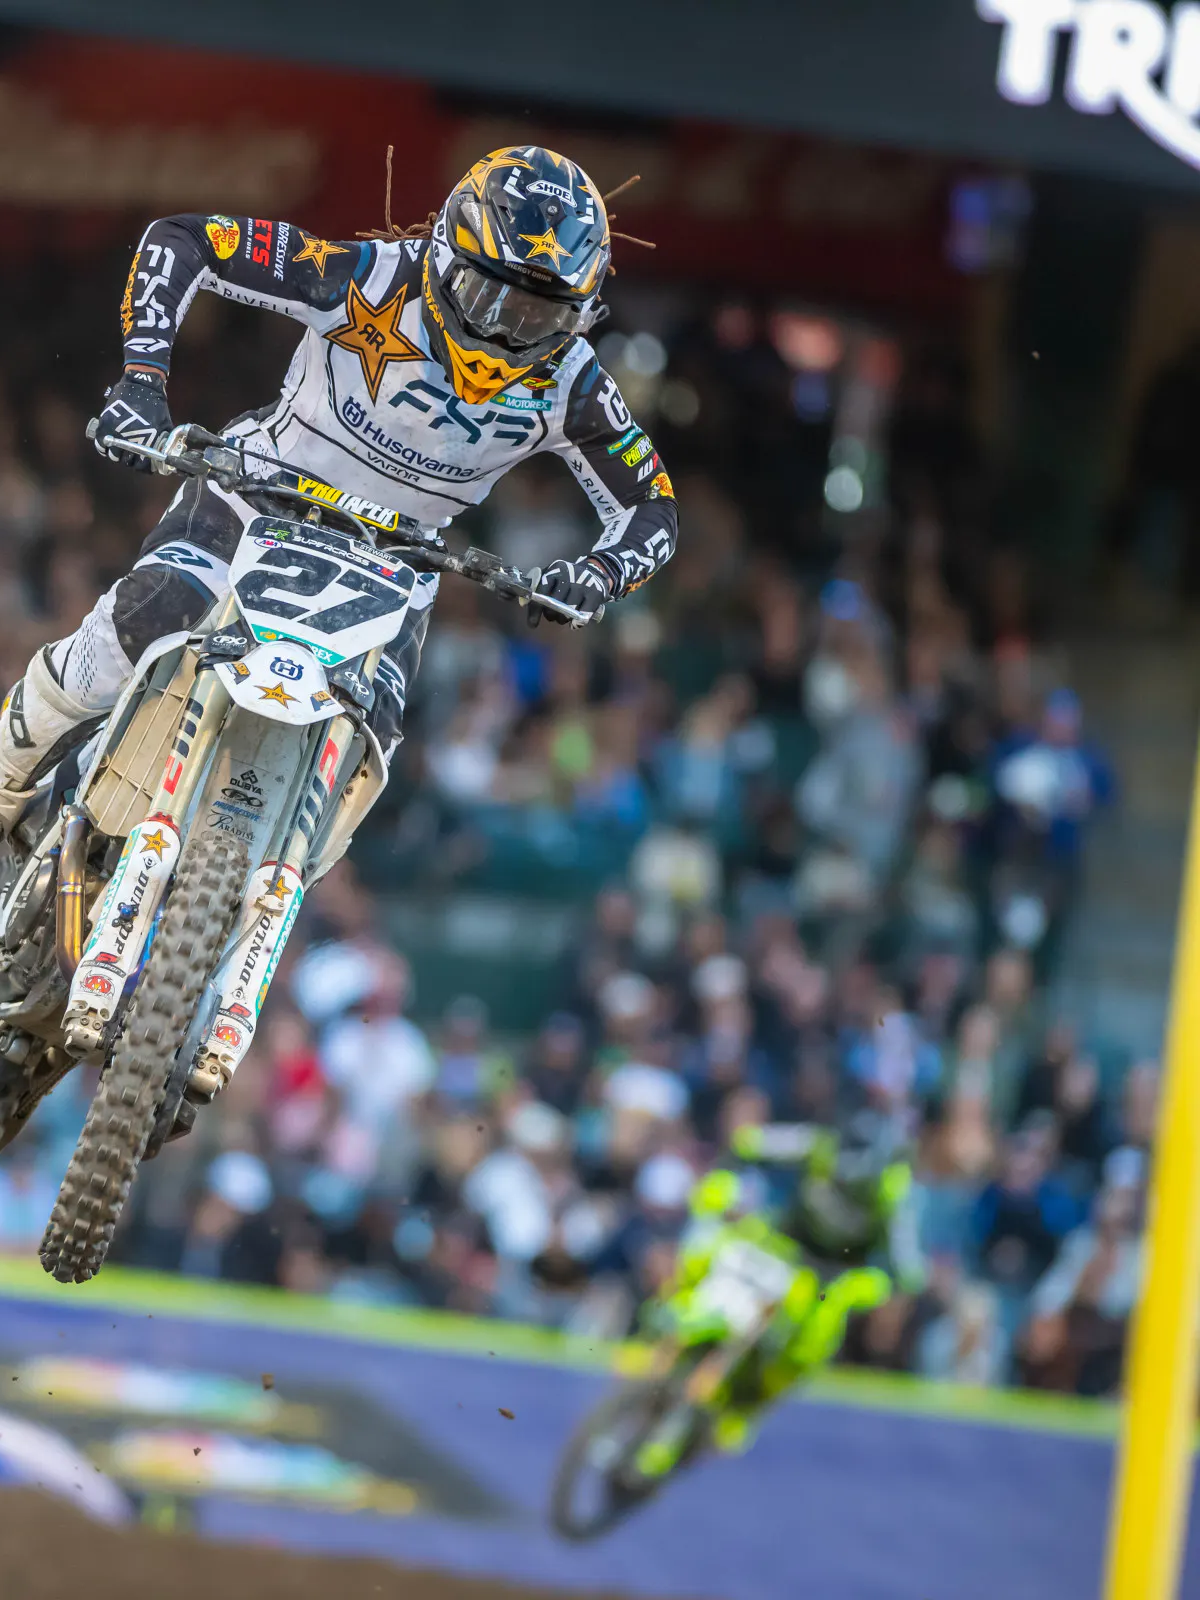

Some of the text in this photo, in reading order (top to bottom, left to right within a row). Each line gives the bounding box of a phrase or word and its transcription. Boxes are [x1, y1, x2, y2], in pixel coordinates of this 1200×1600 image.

[252, 218, 273, 267] ETS
[504, 260, 553, 283] ENERGY DRINK
[222, 287, 294, 316] RIVELL
[505, 396, 549, 410] MOTOREX
[362, 420, 477, 480] Husqvarna
[366, 451, 421, 483] VAPOR
[301, 477, 397, 526] PROTAPER
[292, 535, 371, 567] SUPERCROSS
[359, 543, 394, 562] STEWART
[234, 547, 411, 635] 27
[229, 777, 264, 795] DUBYA
[238, 911, 273, 987] DUNLO
